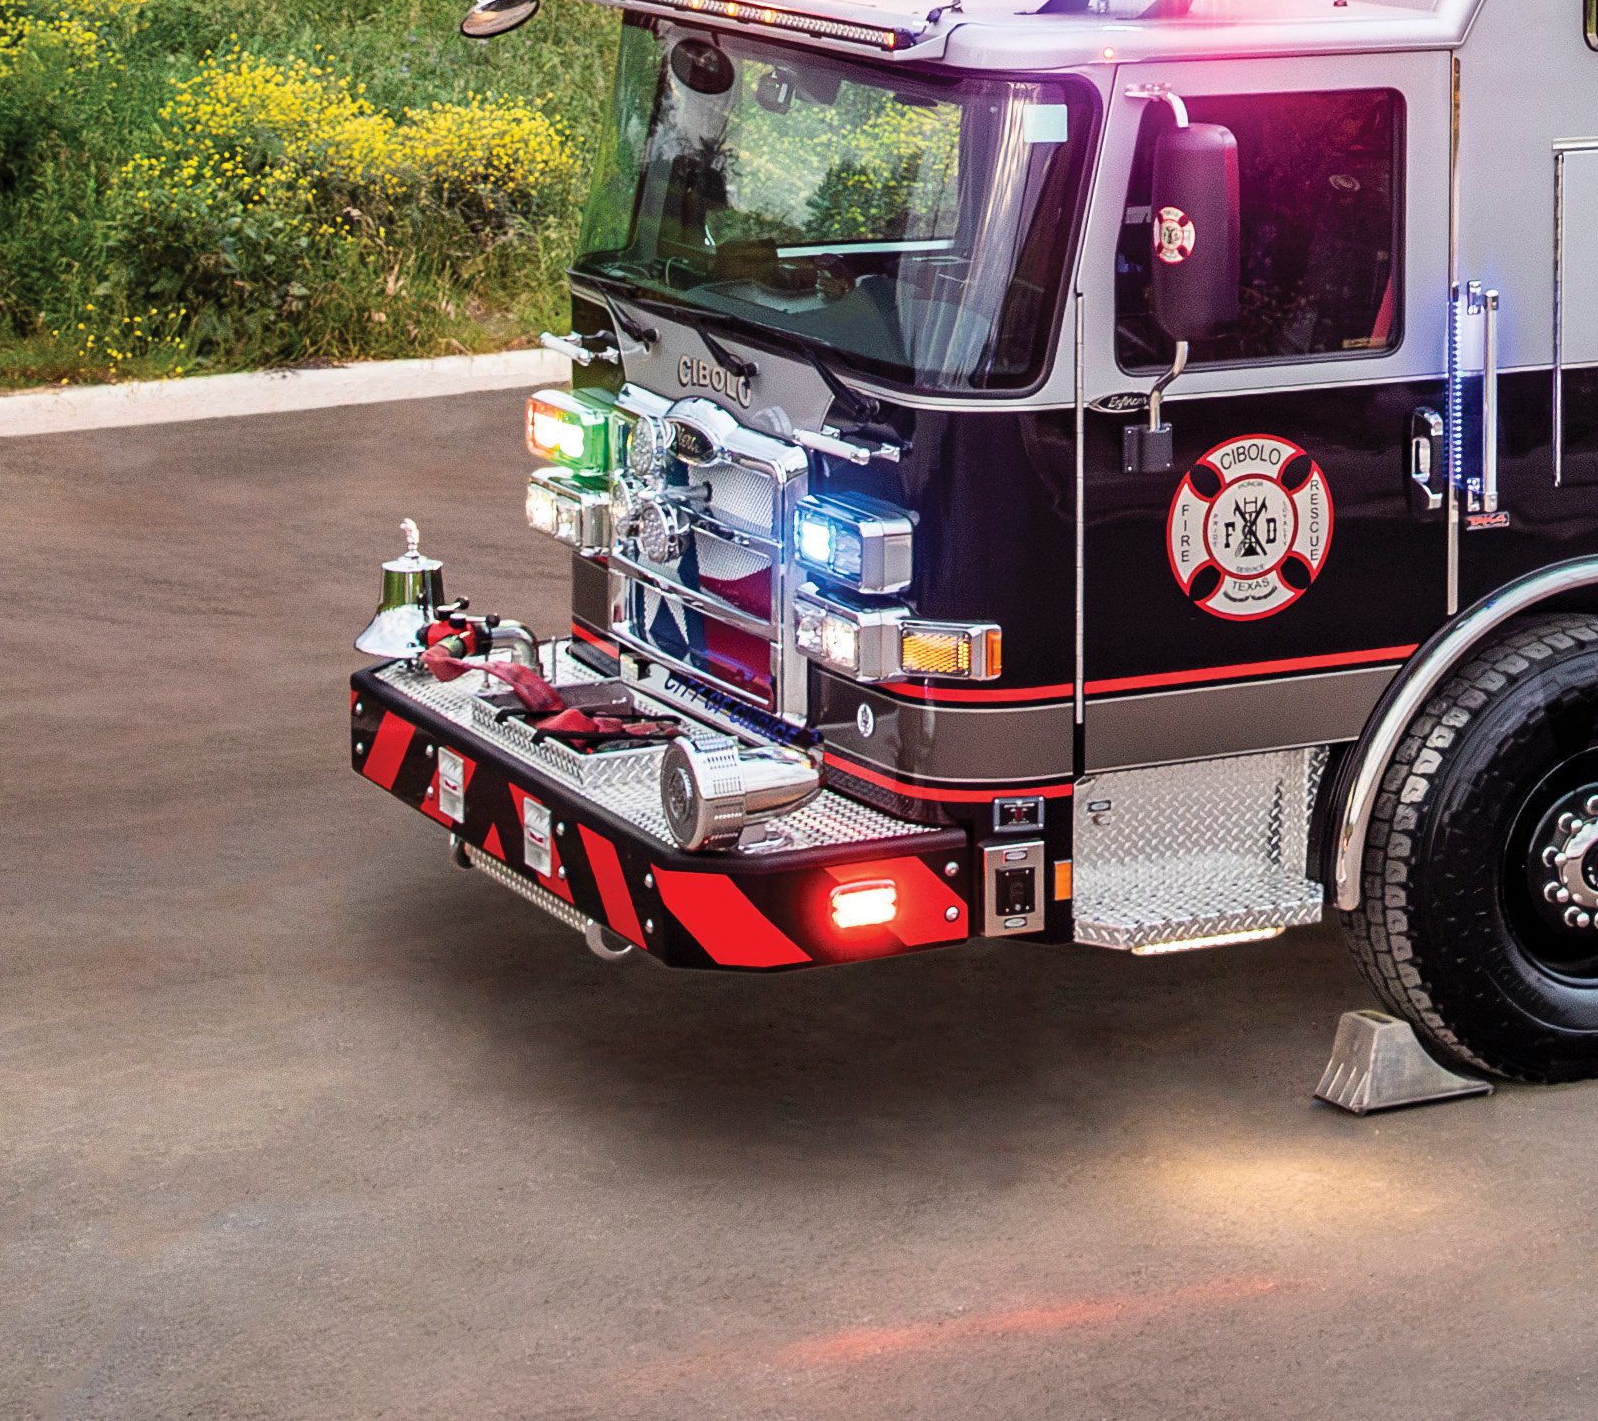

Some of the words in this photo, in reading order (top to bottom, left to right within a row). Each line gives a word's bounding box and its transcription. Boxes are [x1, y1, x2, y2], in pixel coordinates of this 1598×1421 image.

[678, 354, 751, 408] CIBOLO
[1219, 443, 1281, 470] CIBOLO
[1180, 504, 1190, 563] FIRE
[1224, 522, 1235, 548] F
[1265, 517, 1277, 544] D
[1309, 479, 1320, 561] RESCUE
[1232, 577, 1270, 591] TEXAS
